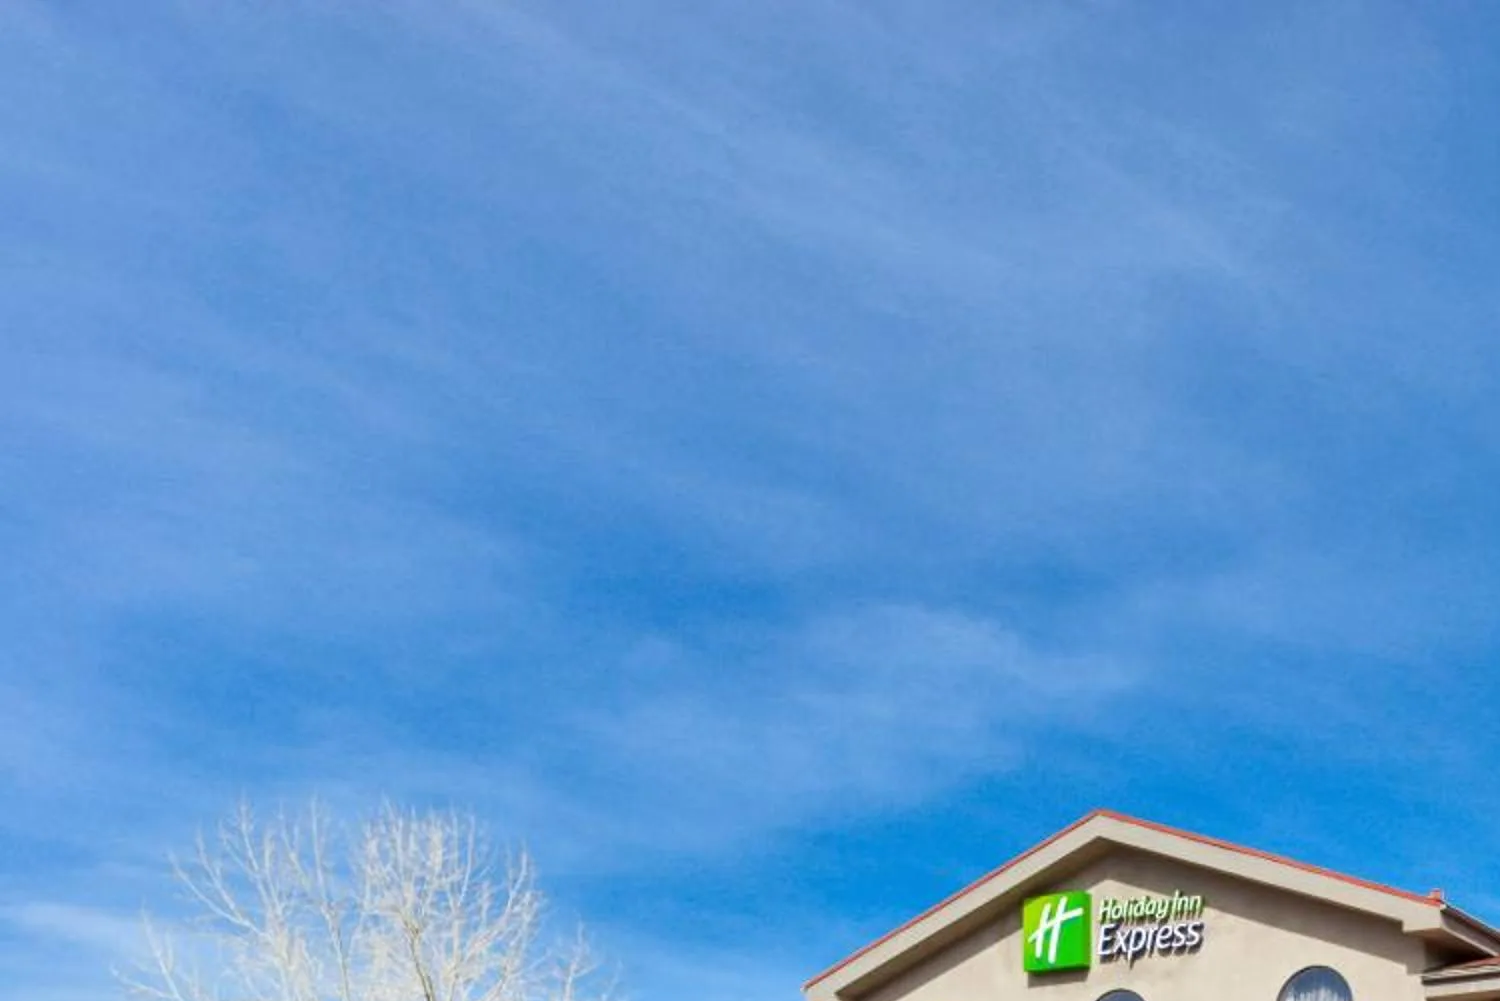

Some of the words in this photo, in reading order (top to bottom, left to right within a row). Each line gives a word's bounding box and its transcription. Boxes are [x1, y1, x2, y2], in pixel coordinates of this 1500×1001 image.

[1100, 895, 1168, 920] Holiday
[1171, 889, 1202, 914] Inn
[1098, 922, 1202, 961] Express
